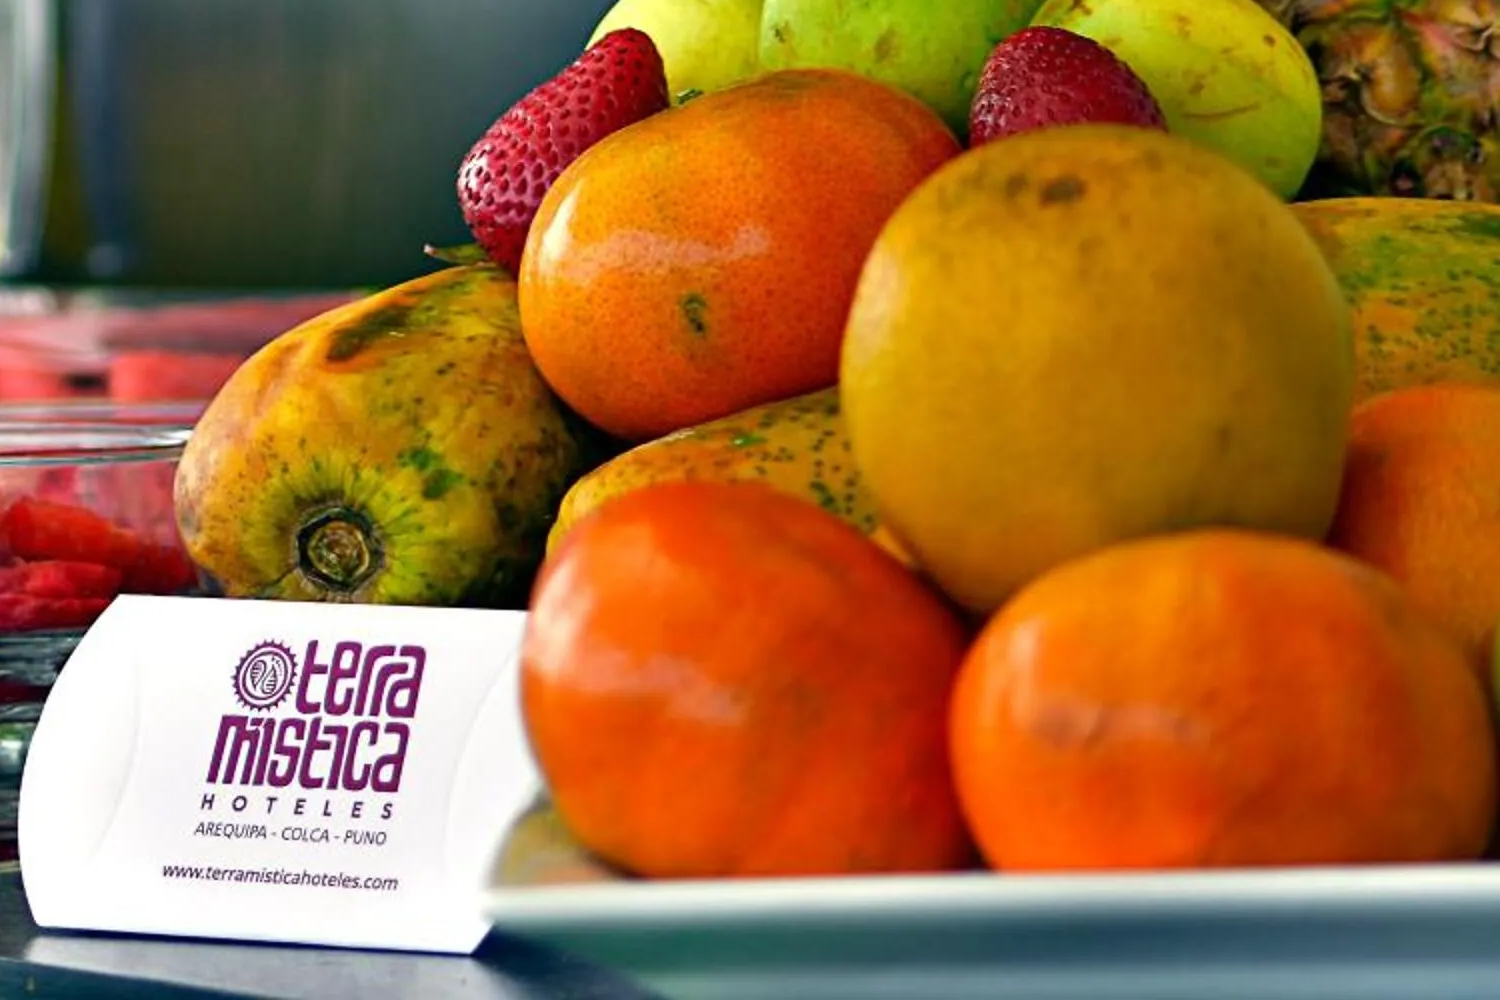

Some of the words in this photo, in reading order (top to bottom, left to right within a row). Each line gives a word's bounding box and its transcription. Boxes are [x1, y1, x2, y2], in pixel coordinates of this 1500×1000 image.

[295, 639, 426, 719] terra
[205, 714, 411, 793] mistica
[200, 793, 394, 821] HOTELES
[193, 821, 267, 840] AREQUIPA
[281, 826, 329, 843] COLCA
[343, 829, 388, 846] PUNO
[162, 865, 399, 891] www.terramisticahoteles.com
